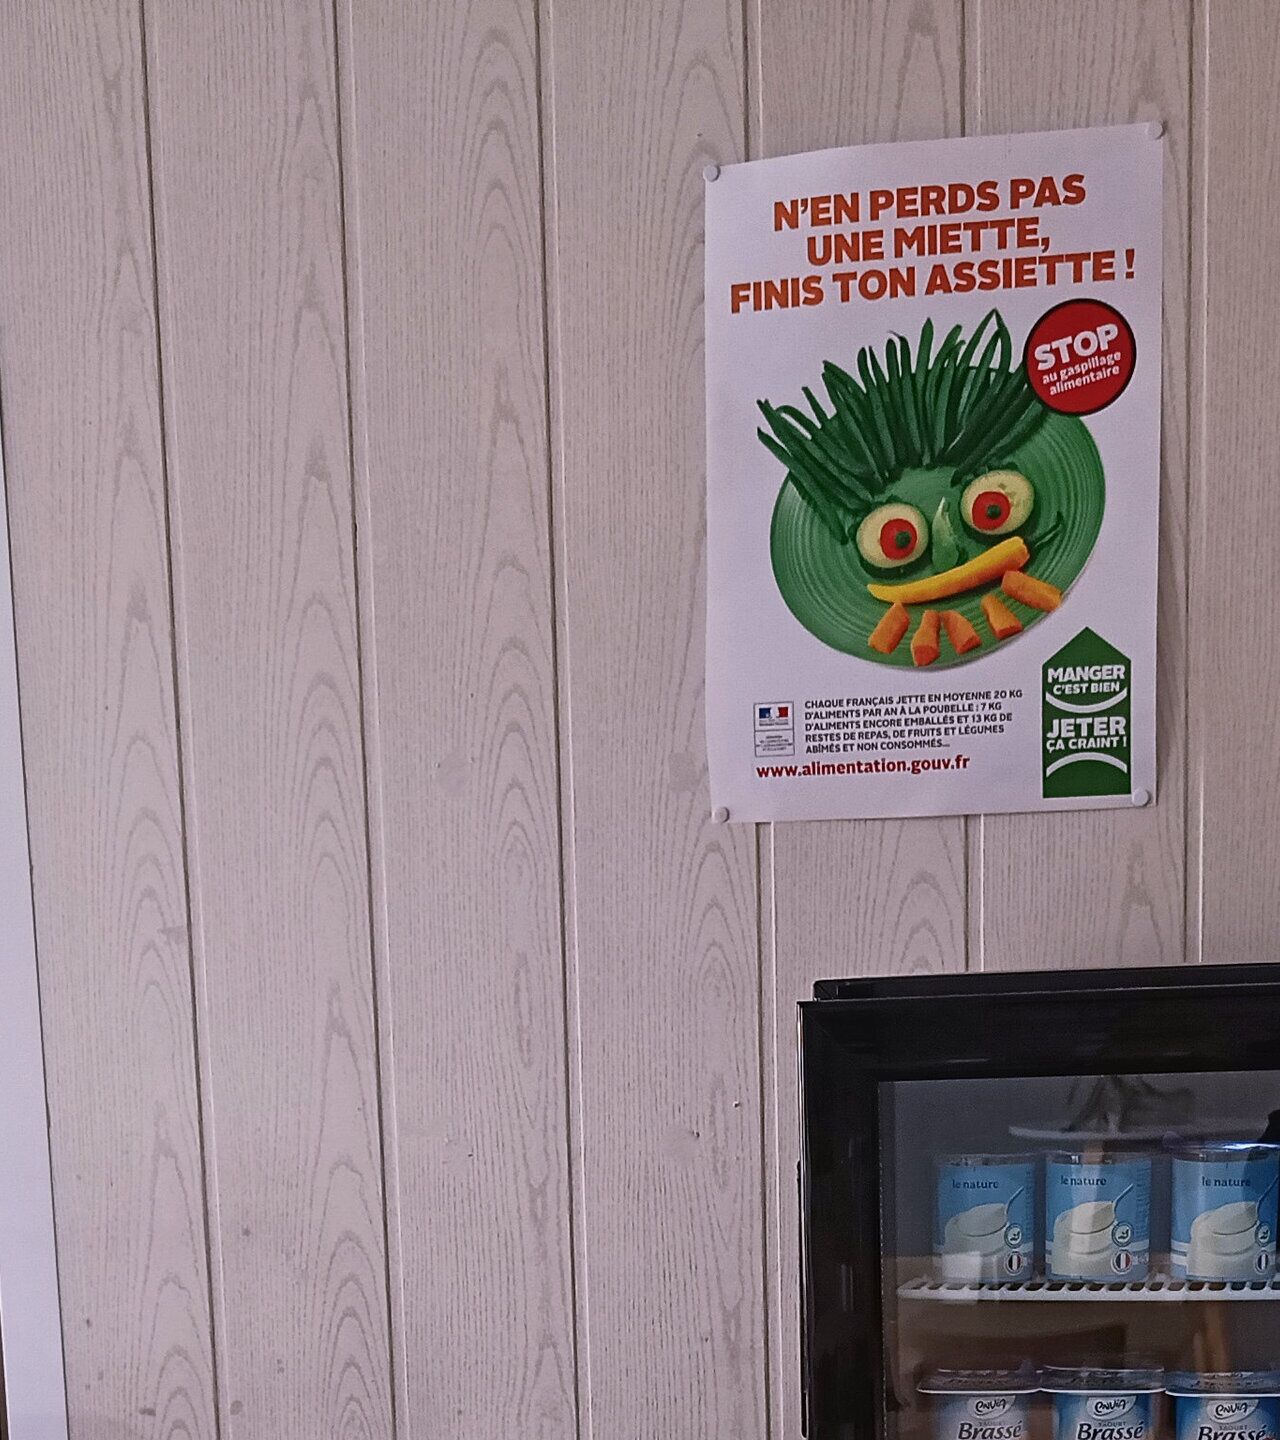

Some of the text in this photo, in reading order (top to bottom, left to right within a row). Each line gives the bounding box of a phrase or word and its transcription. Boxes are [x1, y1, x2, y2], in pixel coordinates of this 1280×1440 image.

[773, 173, 1087, 232] N'EN PERDS PAS
[806, 217, 1050, 266] UNE MIETTE,
[730, 248, 1136, 314] FINIS TON ASSIETTE !
[1034, 323, 1119, 371] STOP
[1042, 351, 1121, 385] au gaspillage
[1049, 365, 1120, 396] alimentaire
[1047, 664, 1126, 683] MANGER
[1090, 681, 1120, 693] BIEN
[804, 689, 1023, 710] CHAQUE FRANÇAIS JETTE EN MOYENNE 20 KG
[862, 708, 882, 717] PAR
[884, 707, 898, 716] AN
[899, 705, 907, 716] À
[908, 706, 921, 715] LA
[923, 703, 974, 715] POUBELLE
[980, 703, 987, 712] 7
[988, 702, 1002, 711] KG
[863, 718, 902, 729] ENCORE
[904, 714, 955, 727] EMBALLÉS
[956, 715, 970, 724] ET
[971, 714, 982, 723] 13
[984, 713, 997, 722] KG
[999, 712, 1013, 722] DE
[1046, 716, 1127, 738] JETER
[805, 724, 1005, 743] RESTES DE REPAS, DE FRUITS ET LÉGUMES
[843, 743, 855, 752] ET
[857, 741, 878, 752] NON
[1046, 738, 1065, 753] ÇA
[1068, 736, 1120, 749] CRAINT
[757, 755, 971, 778] www.alimentation.gouv.fr
[1060, 1175, 1107, 1186] le nature
[1202, 1175, 1251, 1187] le nature
[958, 1420, 1022, 1440] Brassé
[1077, 1421, 1144, 1440] Brassé
